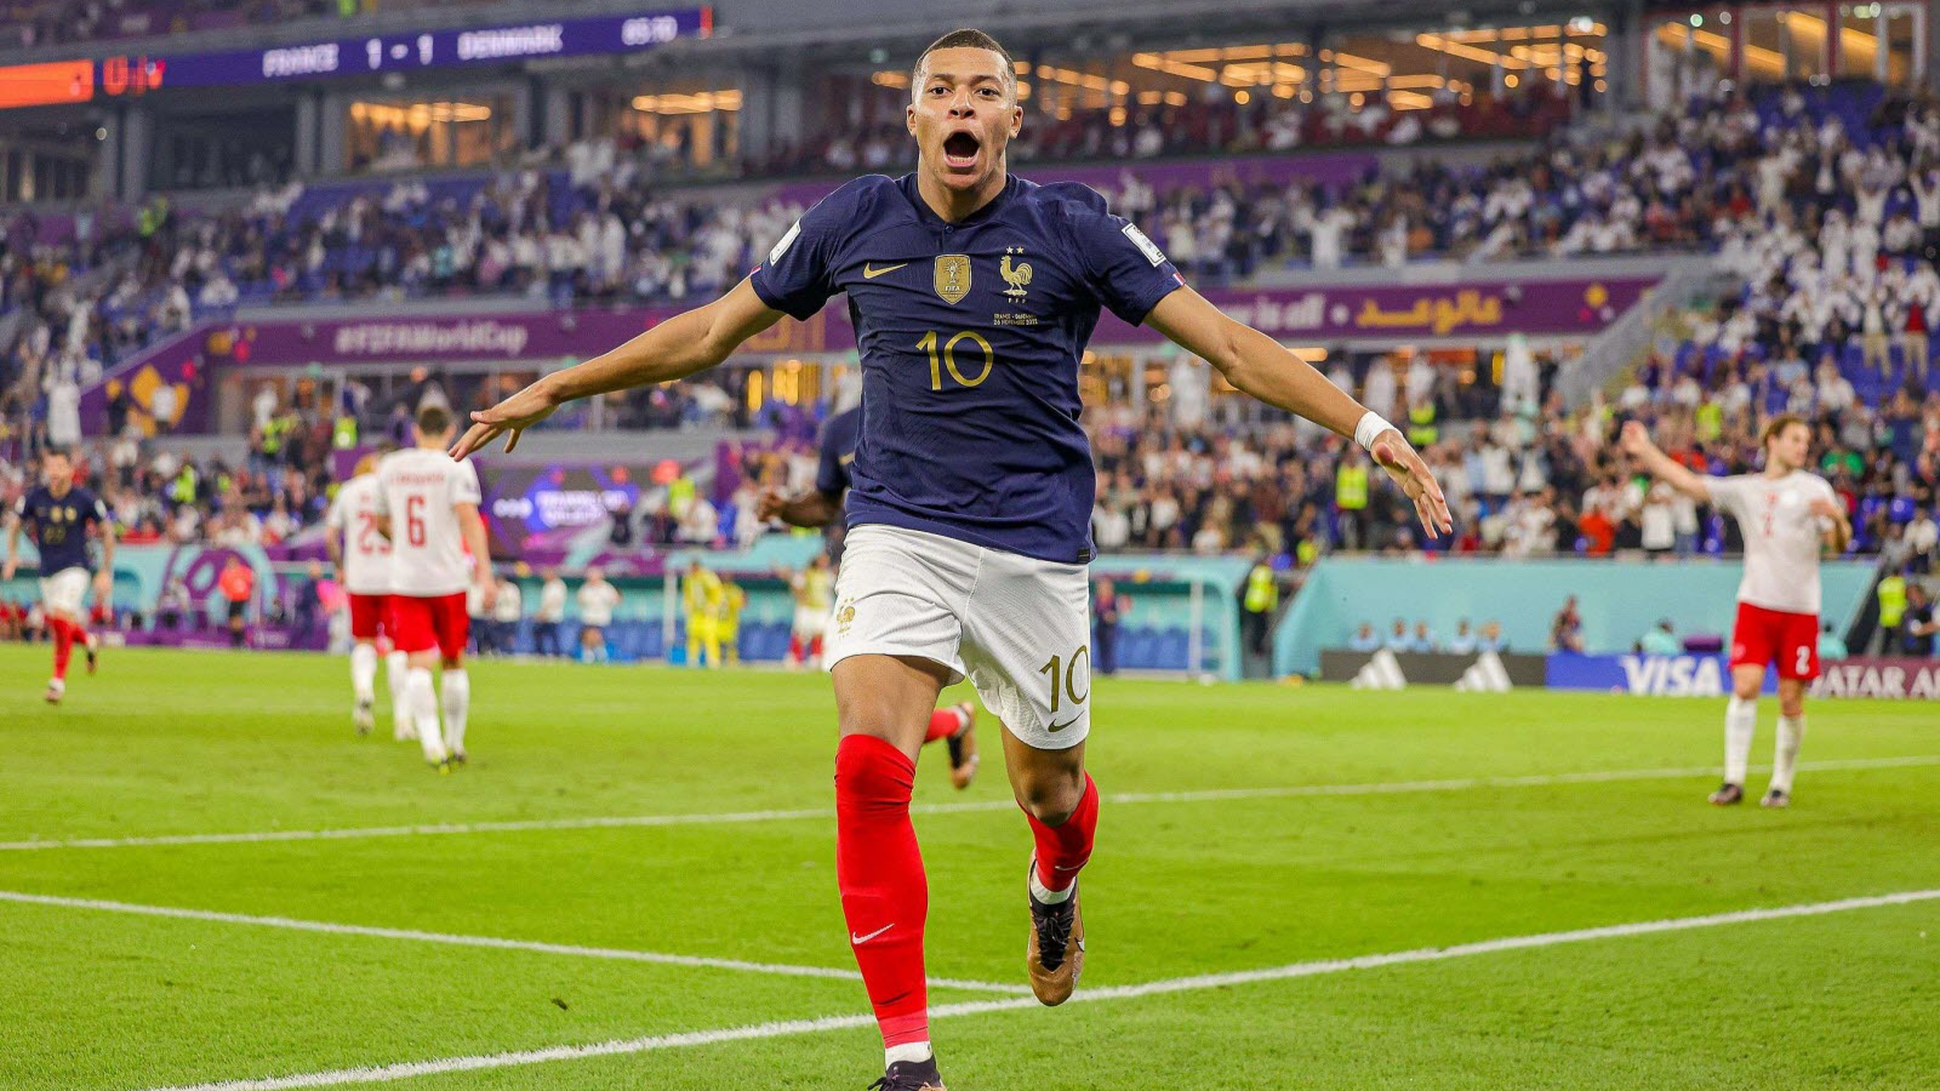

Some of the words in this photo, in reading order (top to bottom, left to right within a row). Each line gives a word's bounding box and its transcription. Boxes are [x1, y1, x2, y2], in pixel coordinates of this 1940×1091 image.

[366, 38, 381, 70] 1
[417, 34, 433, 65] 1
[915, 330, 994, 391] 10
[407, 495, 426, 547] 6
[1039, 645, 1089, 713] 10
[1621, 655, 1723, 697] VISA
